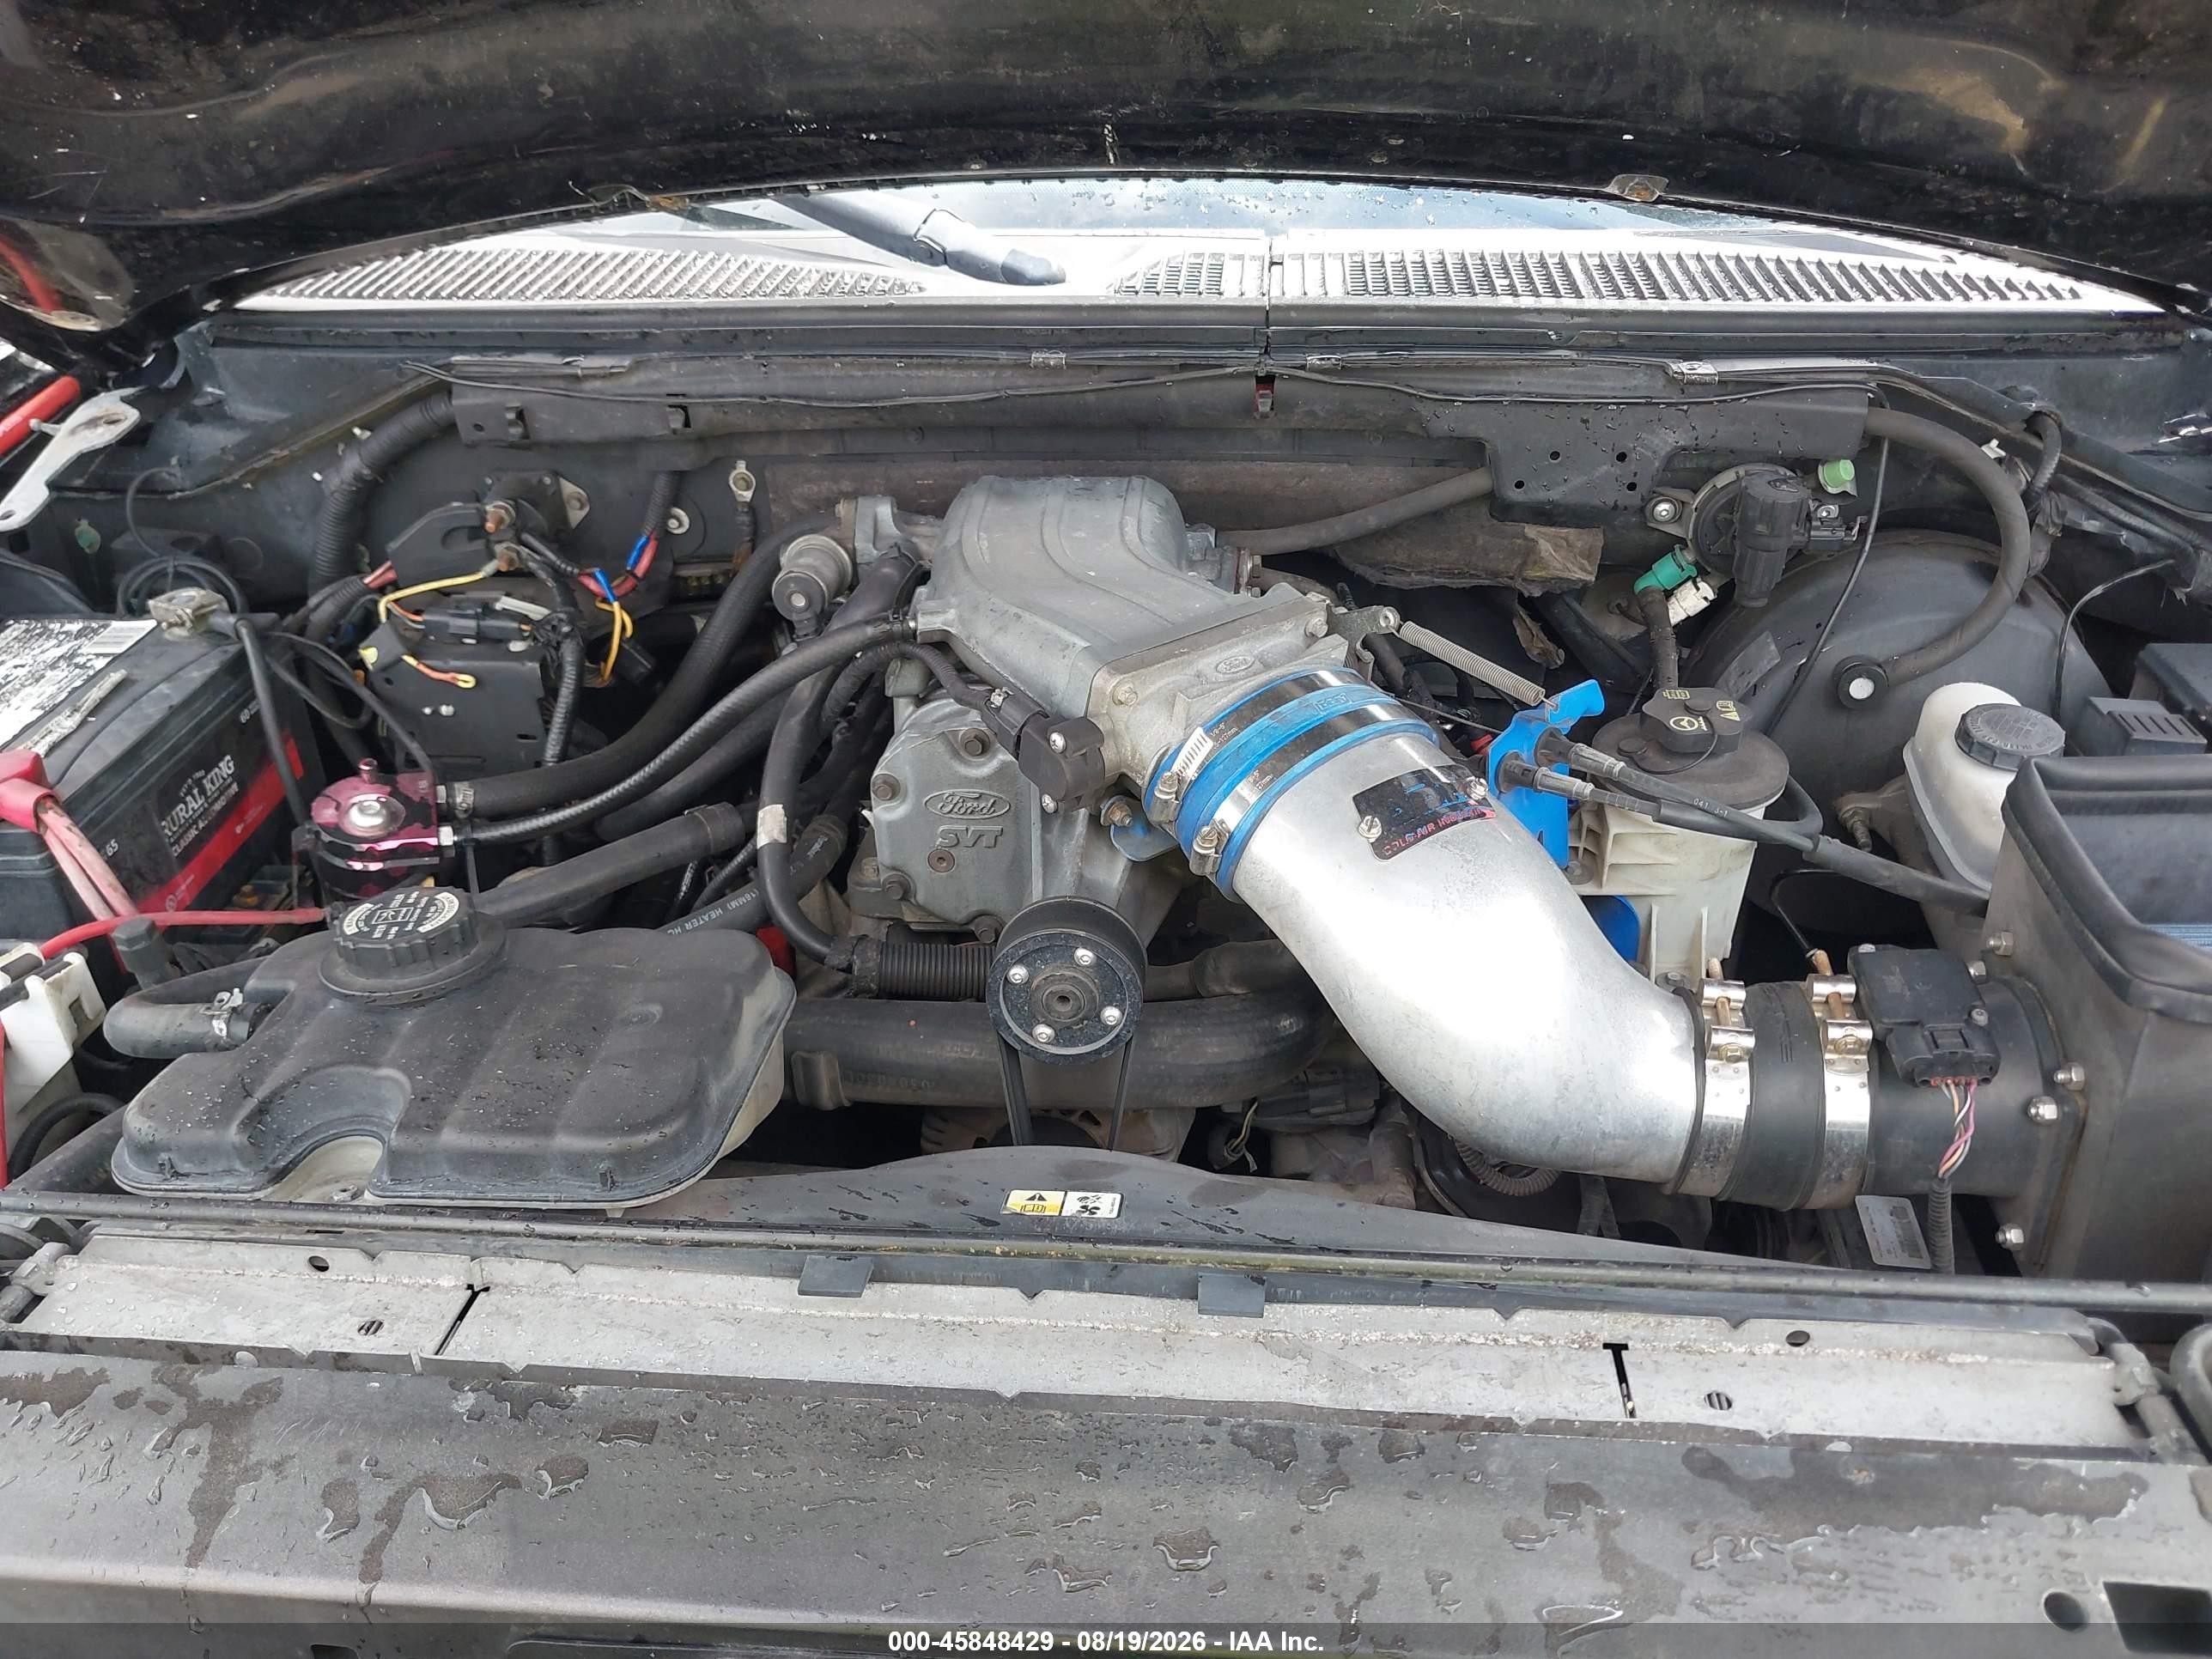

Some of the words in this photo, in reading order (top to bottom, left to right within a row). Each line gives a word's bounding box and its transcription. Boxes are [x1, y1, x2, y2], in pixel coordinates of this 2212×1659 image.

[161, 787, 205, 836] RURAL
[203, 754, 235, 796] KING
[938, 791, 997, 816] Ford
[106, 838, 118, 856] 65
[934, 824, 1004, 848] SVT
[727, 889, 759, 911] (16MM)
[685, 907, 724, 931] HEATER
